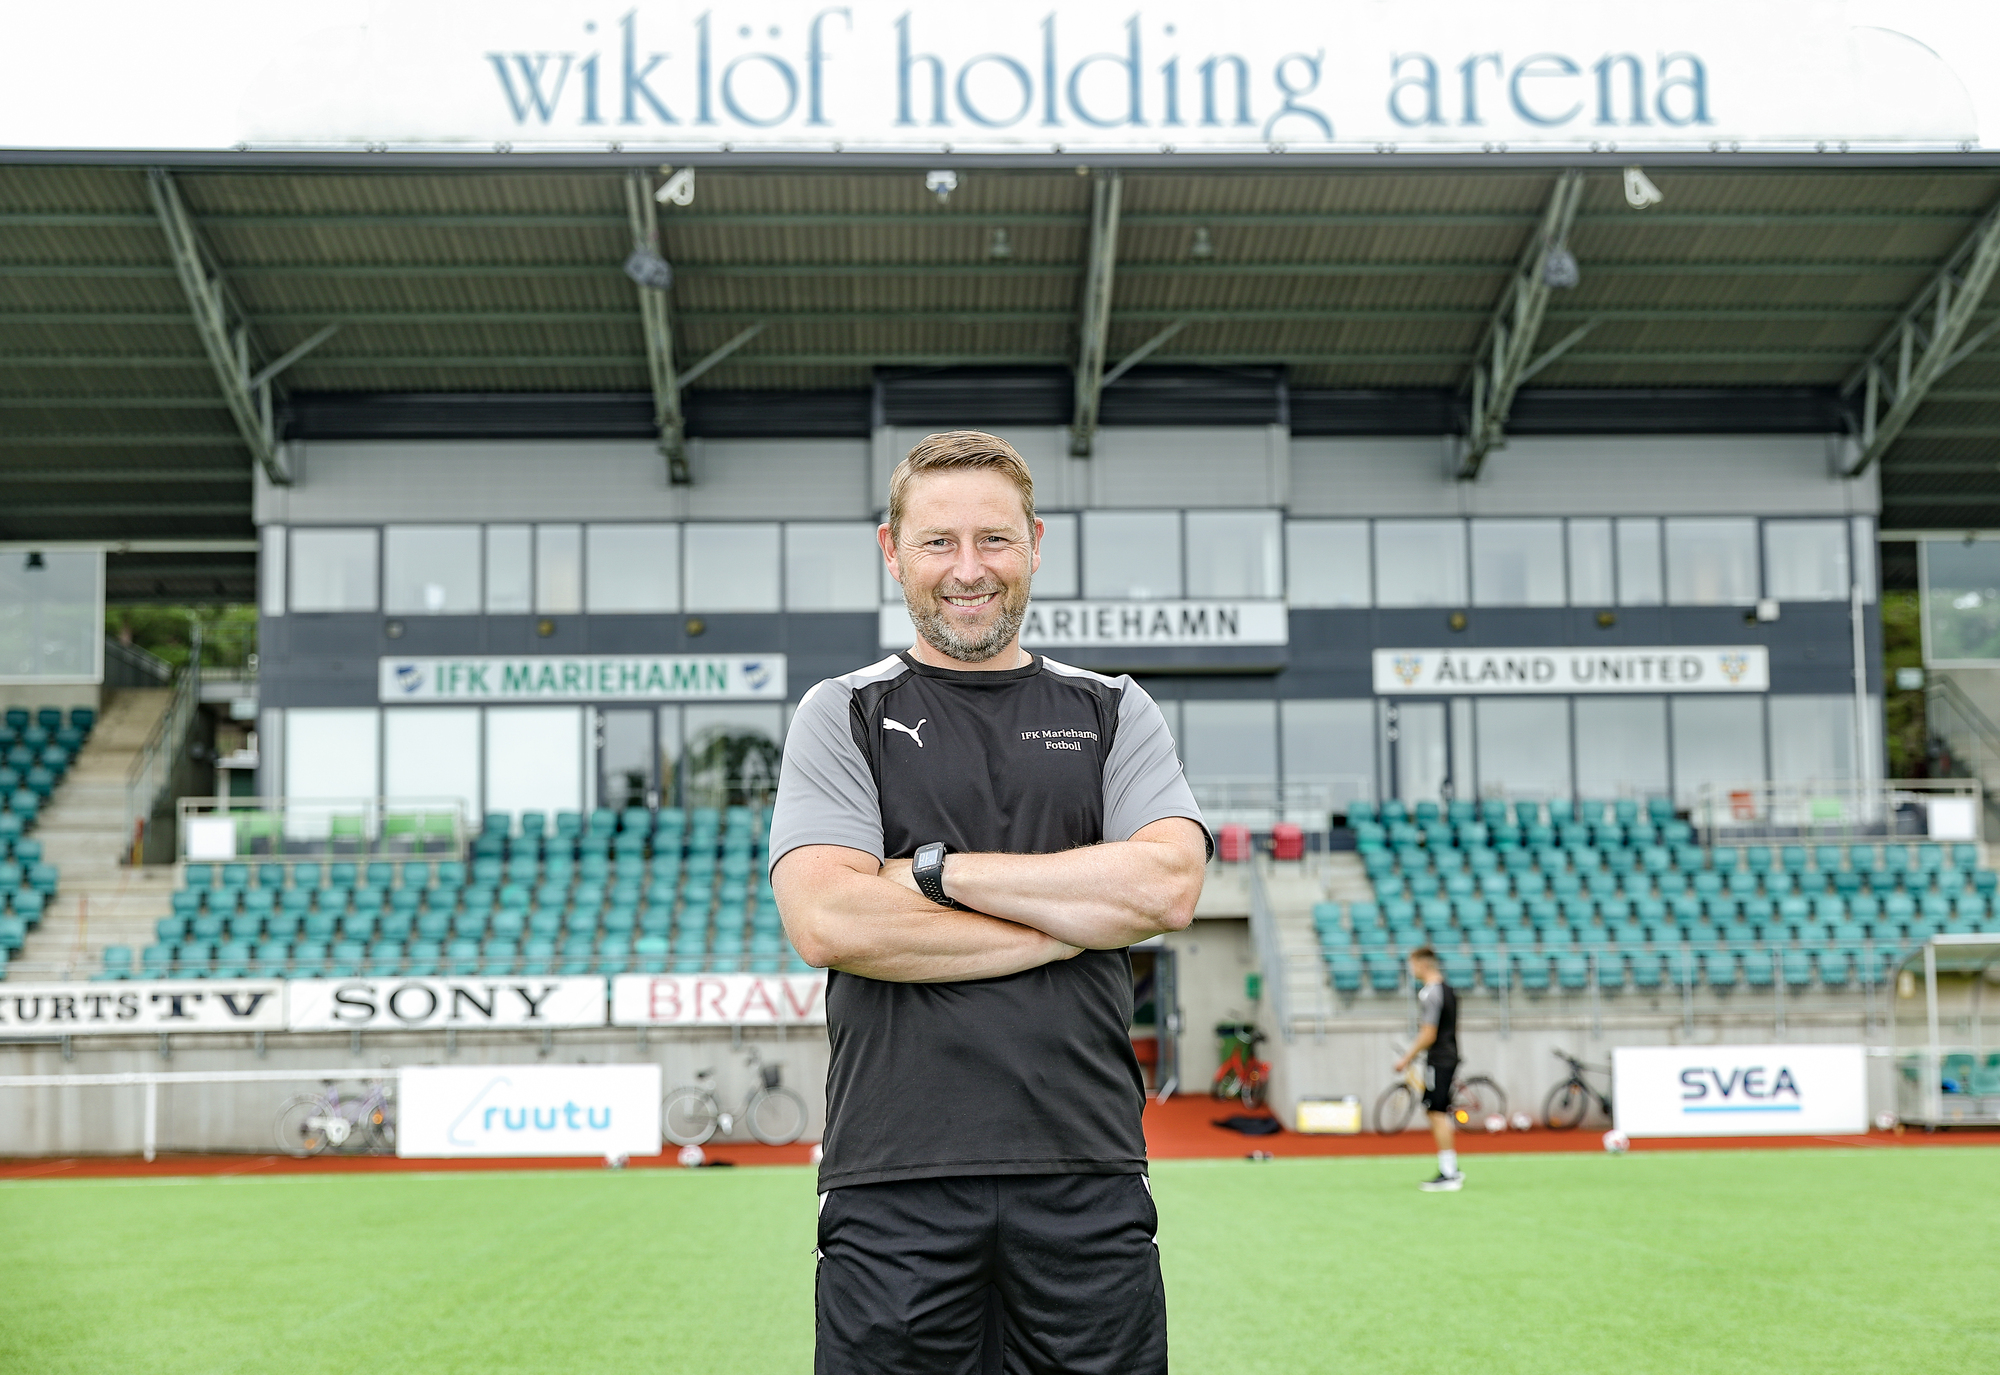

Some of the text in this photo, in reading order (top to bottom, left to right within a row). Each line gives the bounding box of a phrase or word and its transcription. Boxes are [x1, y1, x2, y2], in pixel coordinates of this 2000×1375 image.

[484, 5, 1717, 143] wiklöf holding arena
[1022, 608, 1239, 638] ARIEHAMN
[434, 662, 728, 693] IFK MARIEHAMN
[1434, 647, 1704, 684] ÅLAND UNITED
[1020, 728, 1098, 742] IFK Mariehamn
[1045, 739, 1082, 751] Fotboll
[150, 993, 275, 1018] TV
[331, 981, 559, 1025] SONY
[647, 977, 824, 1021] BRAV
[1680, 1066, 1801, 1100] SVEA
[482, 1100, 612, 1131] ruutu
